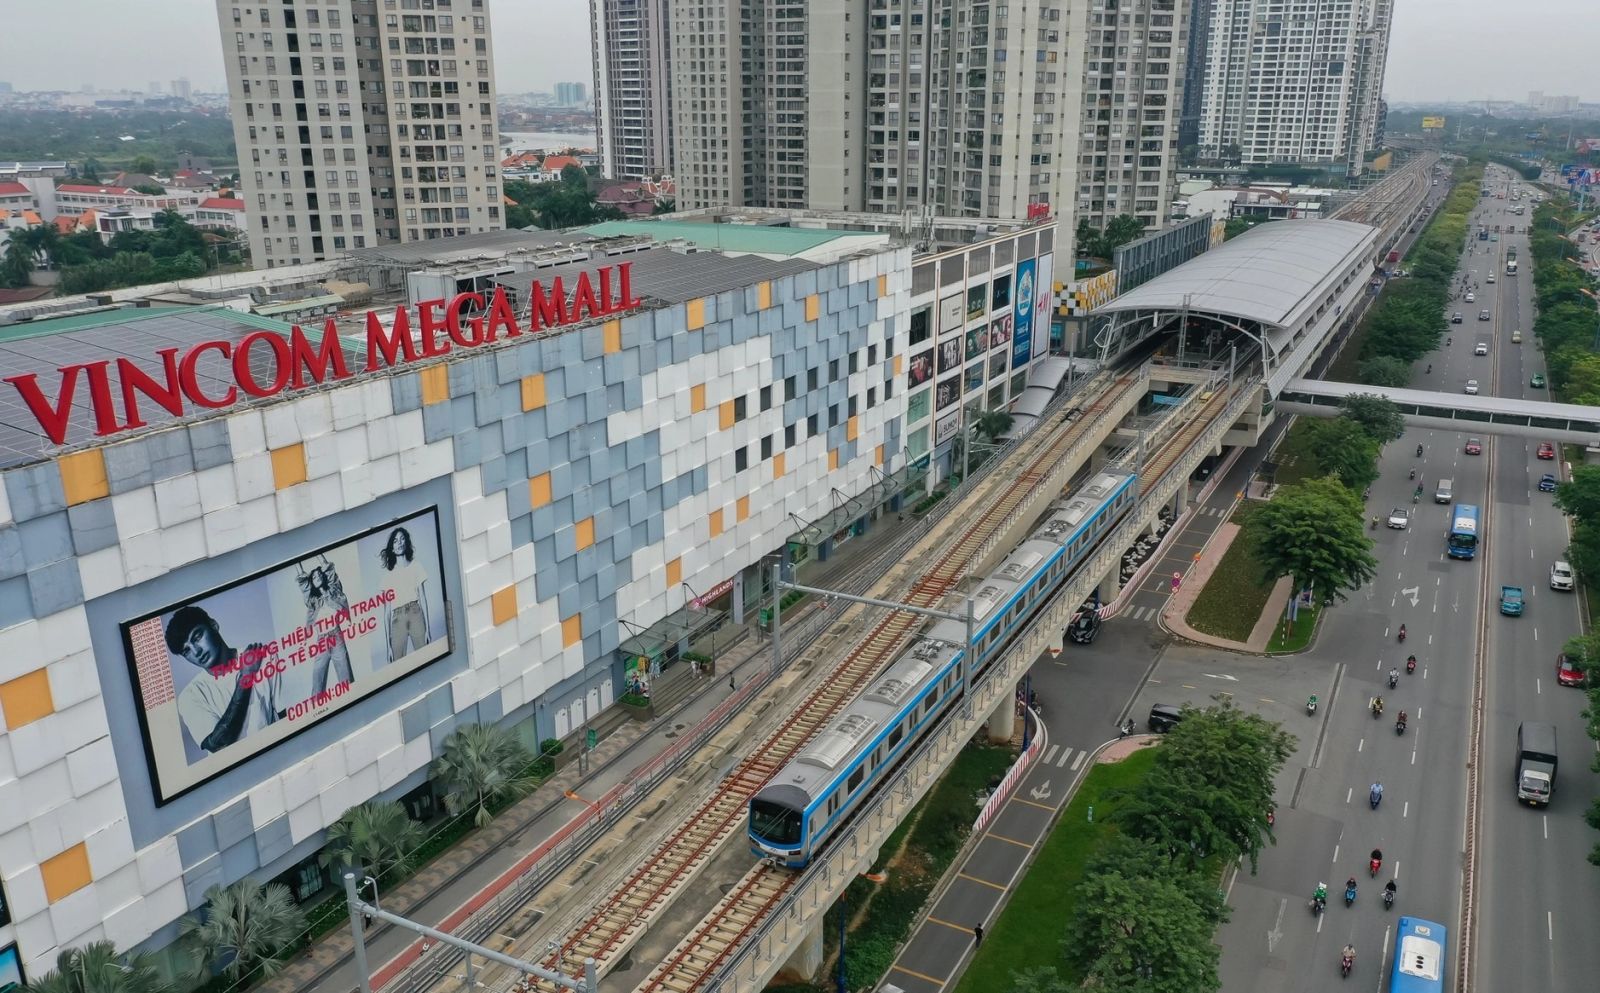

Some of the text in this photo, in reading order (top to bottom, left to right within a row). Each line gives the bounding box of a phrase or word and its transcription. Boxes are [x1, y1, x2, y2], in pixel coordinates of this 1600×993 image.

[4, 261, 641, 445] VINCOM MEGA MALL
[351, 589, 395, 617] TRANG
[701, 579, 733, 603] HIGHLANDS
[359, 617, 377, 634] ÚC
[286, 680, 351, 721] COTTON:ON
